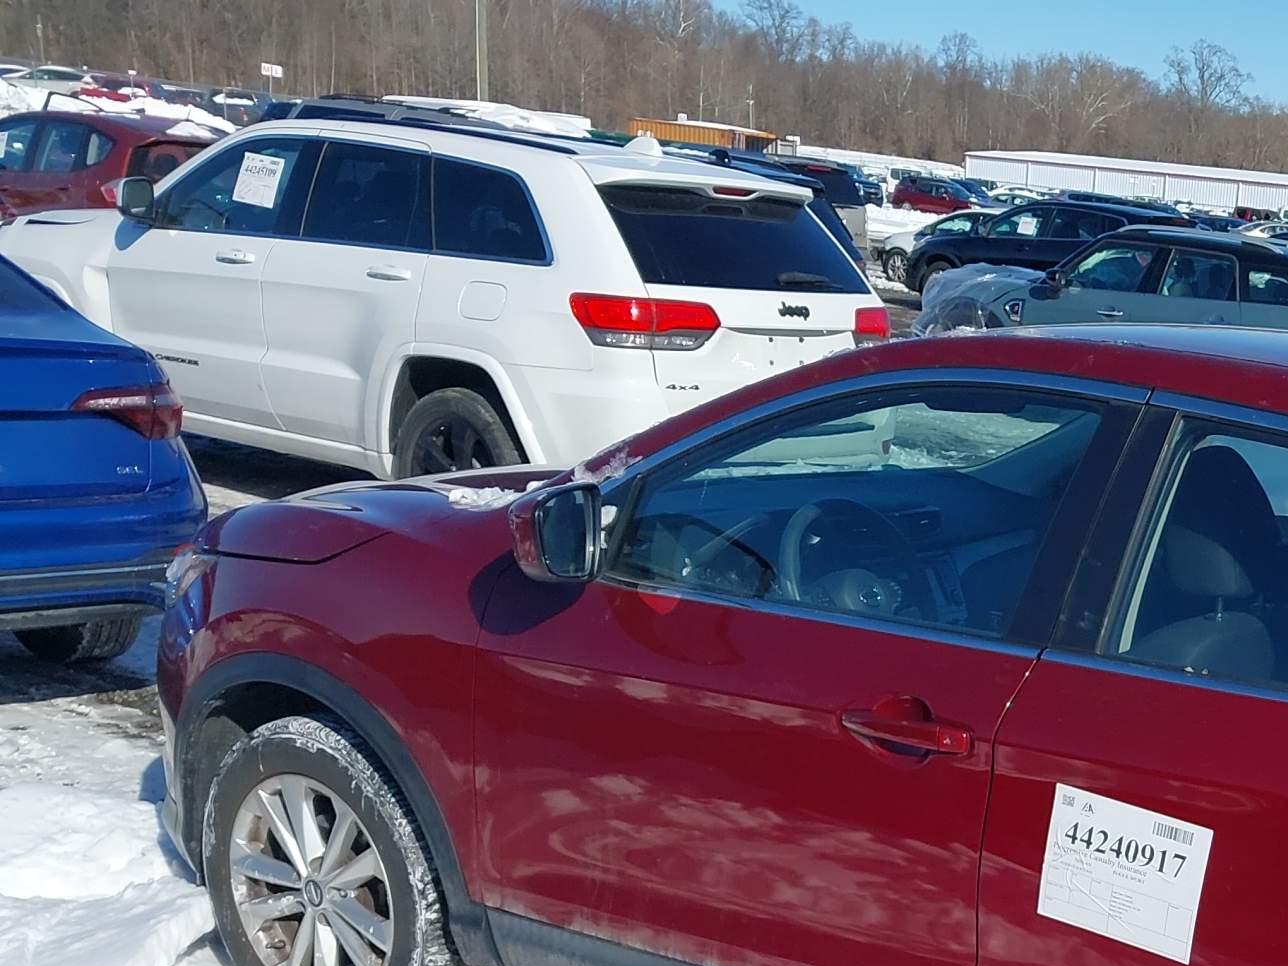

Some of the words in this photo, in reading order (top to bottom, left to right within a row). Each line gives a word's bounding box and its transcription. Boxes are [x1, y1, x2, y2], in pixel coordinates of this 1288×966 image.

[778, 301, 810, 321] Jeep
[665, 383, 701, 391] 4x4
[1065, 821, 1187, 878] 44240917
